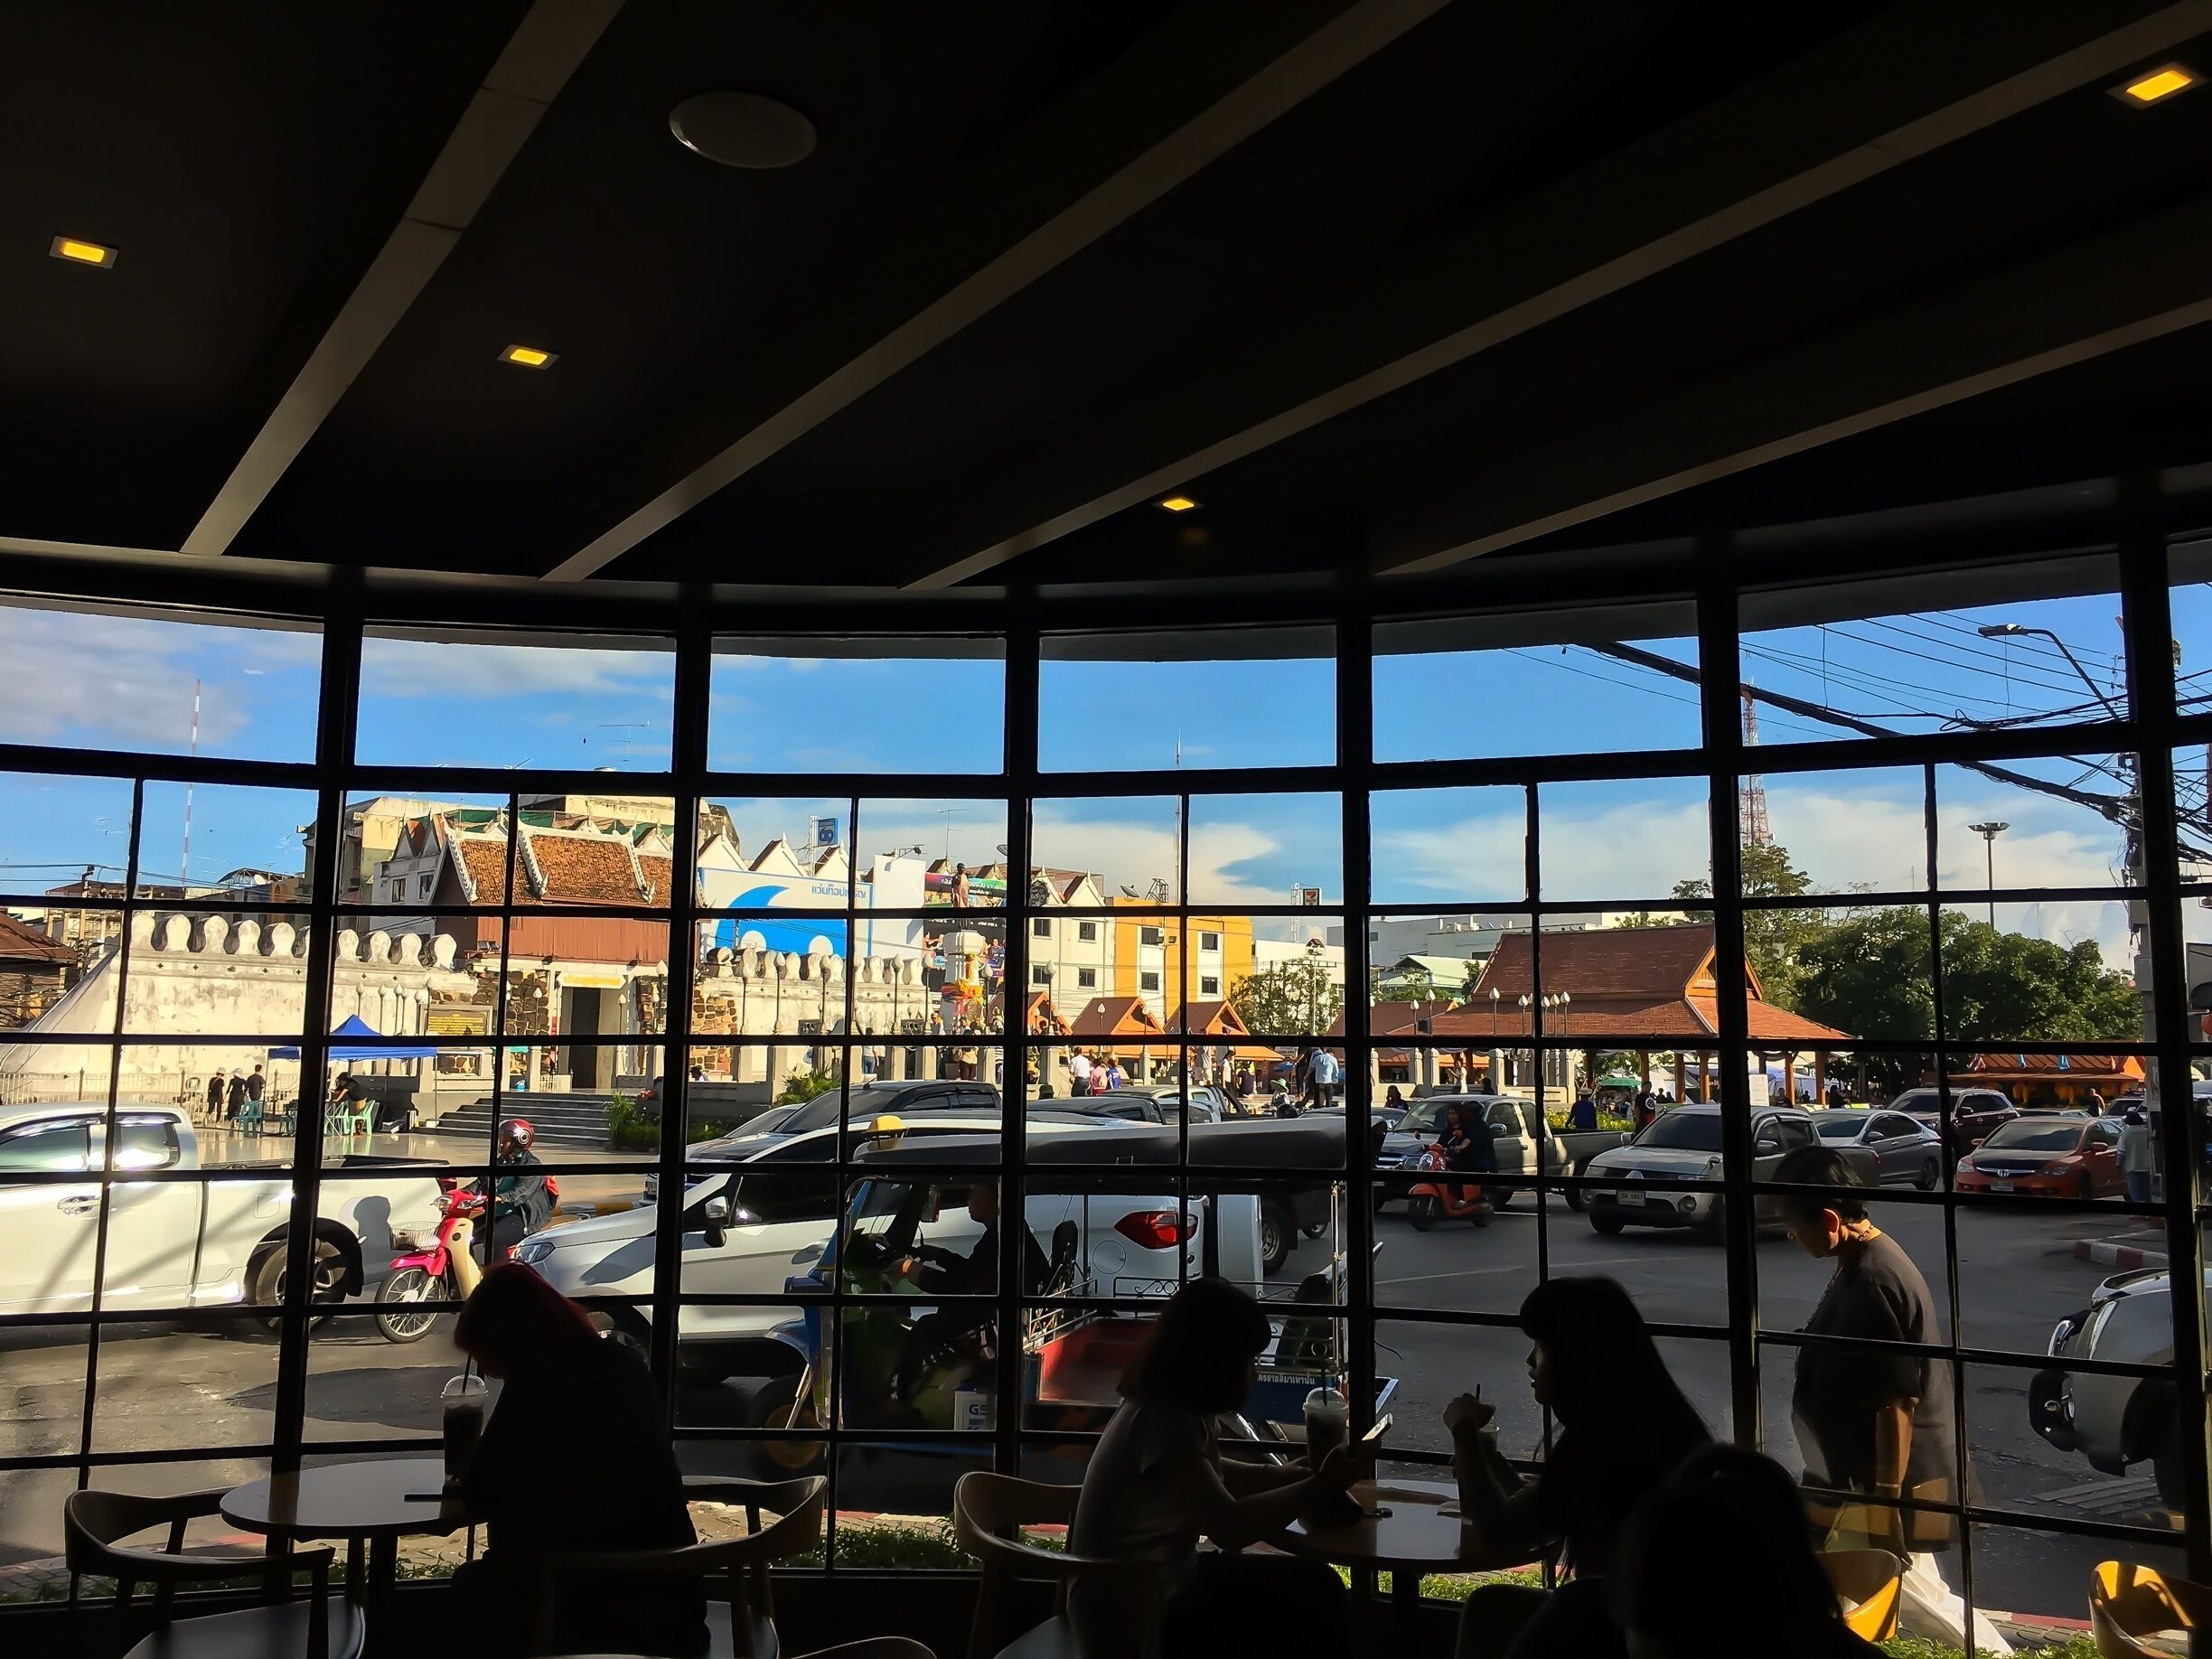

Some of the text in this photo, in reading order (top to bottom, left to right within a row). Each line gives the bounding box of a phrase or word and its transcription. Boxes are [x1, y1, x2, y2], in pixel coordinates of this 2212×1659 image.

[811, 883, 867, 898] แว่นท็อปเริญ
